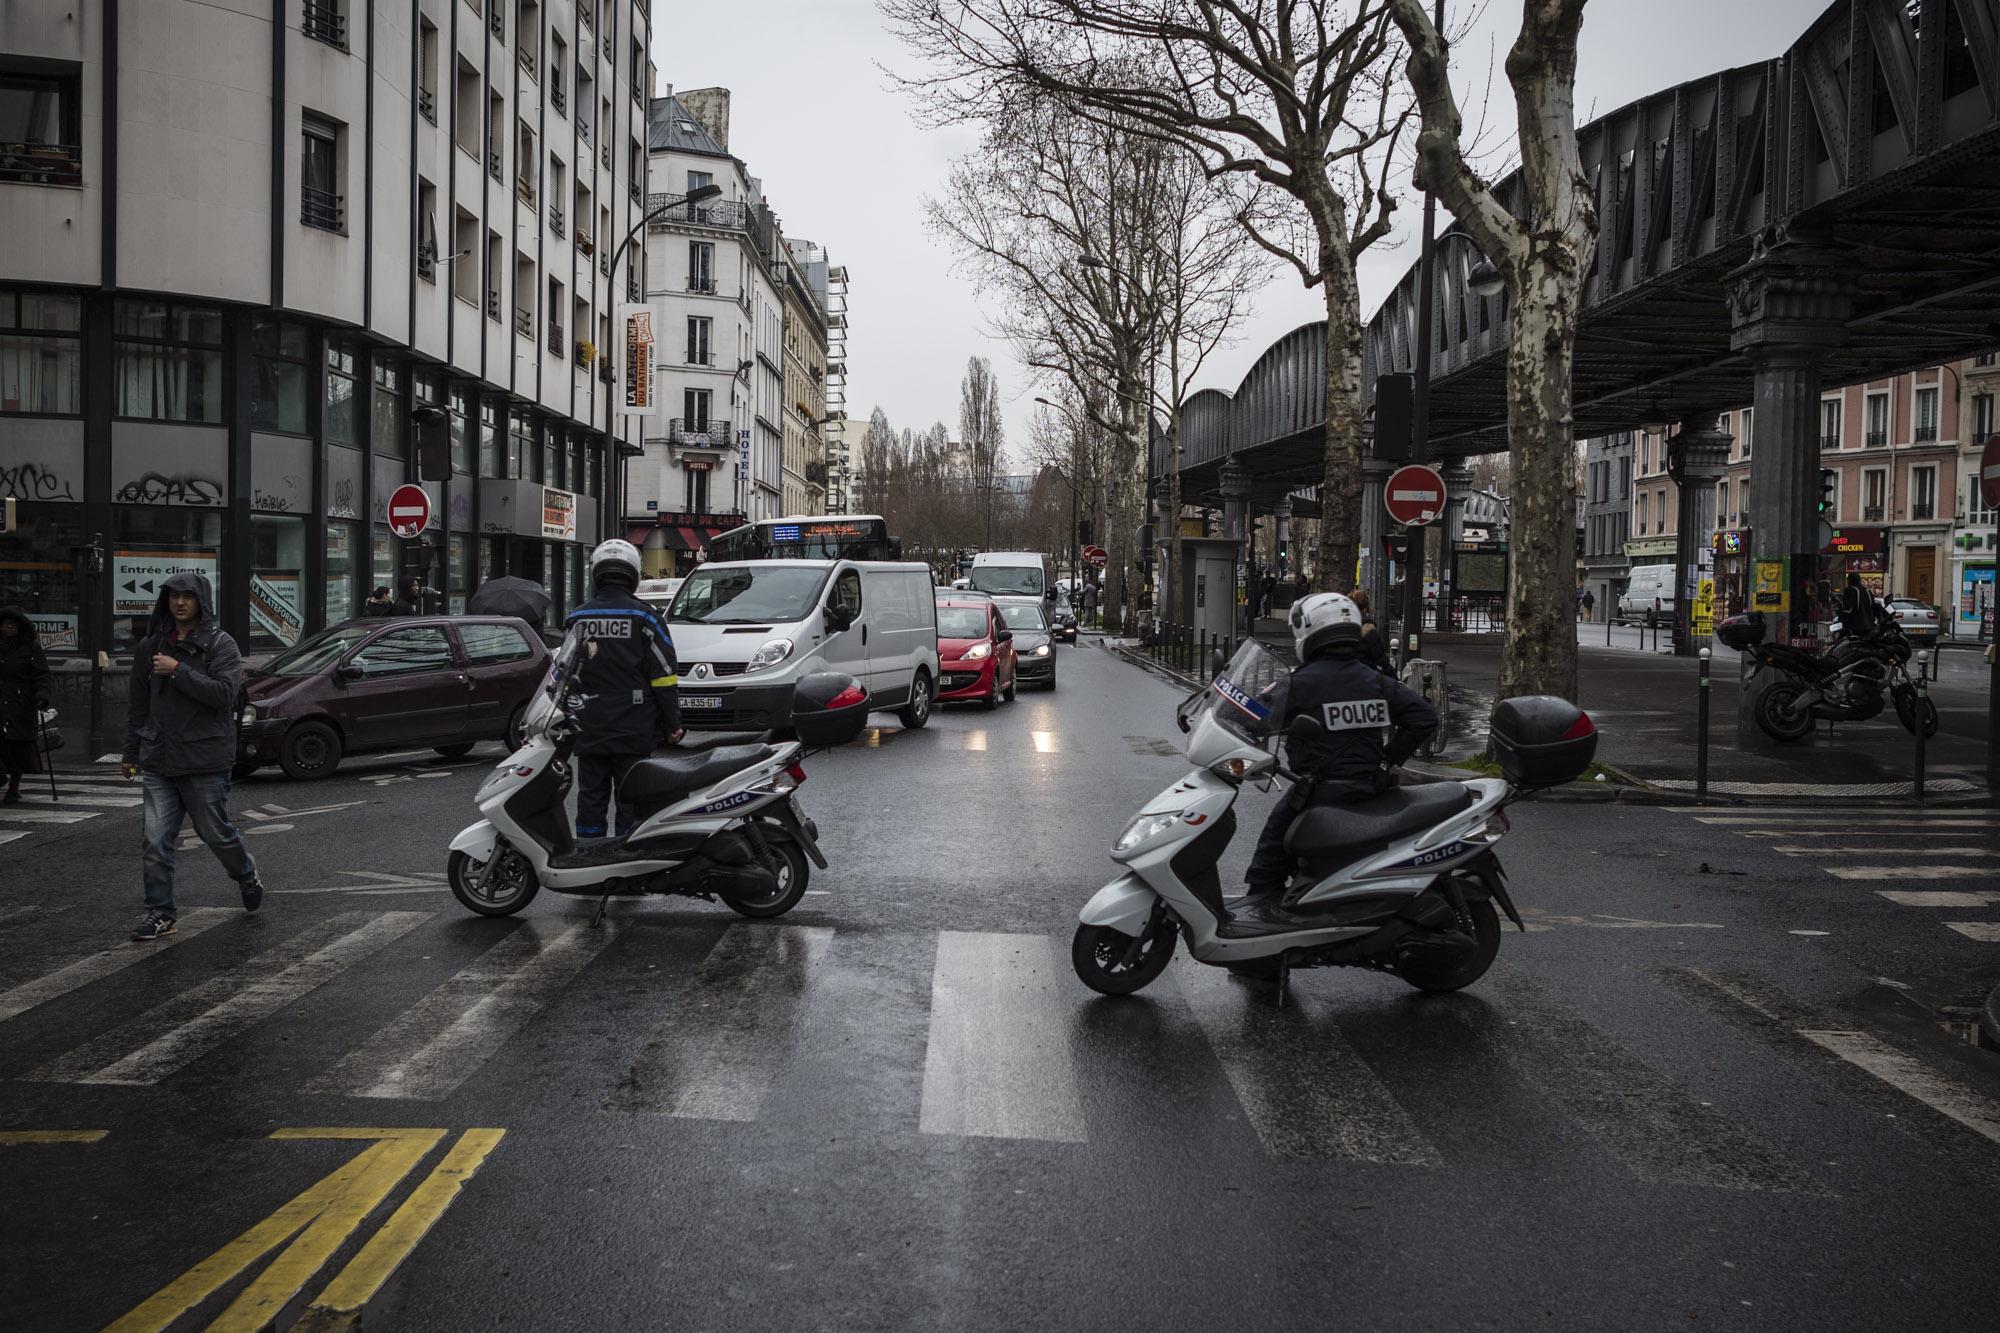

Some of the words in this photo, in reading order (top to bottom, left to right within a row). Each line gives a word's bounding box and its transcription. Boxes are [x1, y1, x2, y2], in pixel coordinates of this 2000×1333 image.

[627, 389, 636, 405] LA
[690, 462, 708, 470] HOTEL
[740, 430, 750, 480] HOTEL
[1837, 544, 1864, 552] CHICKEN
[120, 565, 162, 574] Entrée
[259, 592, 299, 628] PLATEFORME
[1218, 679, 1250, 706] POLICE
[1328, 702, 1385, 726] POLICE
[705, 792, 750, 813] POLICE
[1414, 842, 1463, 866] POLICE
